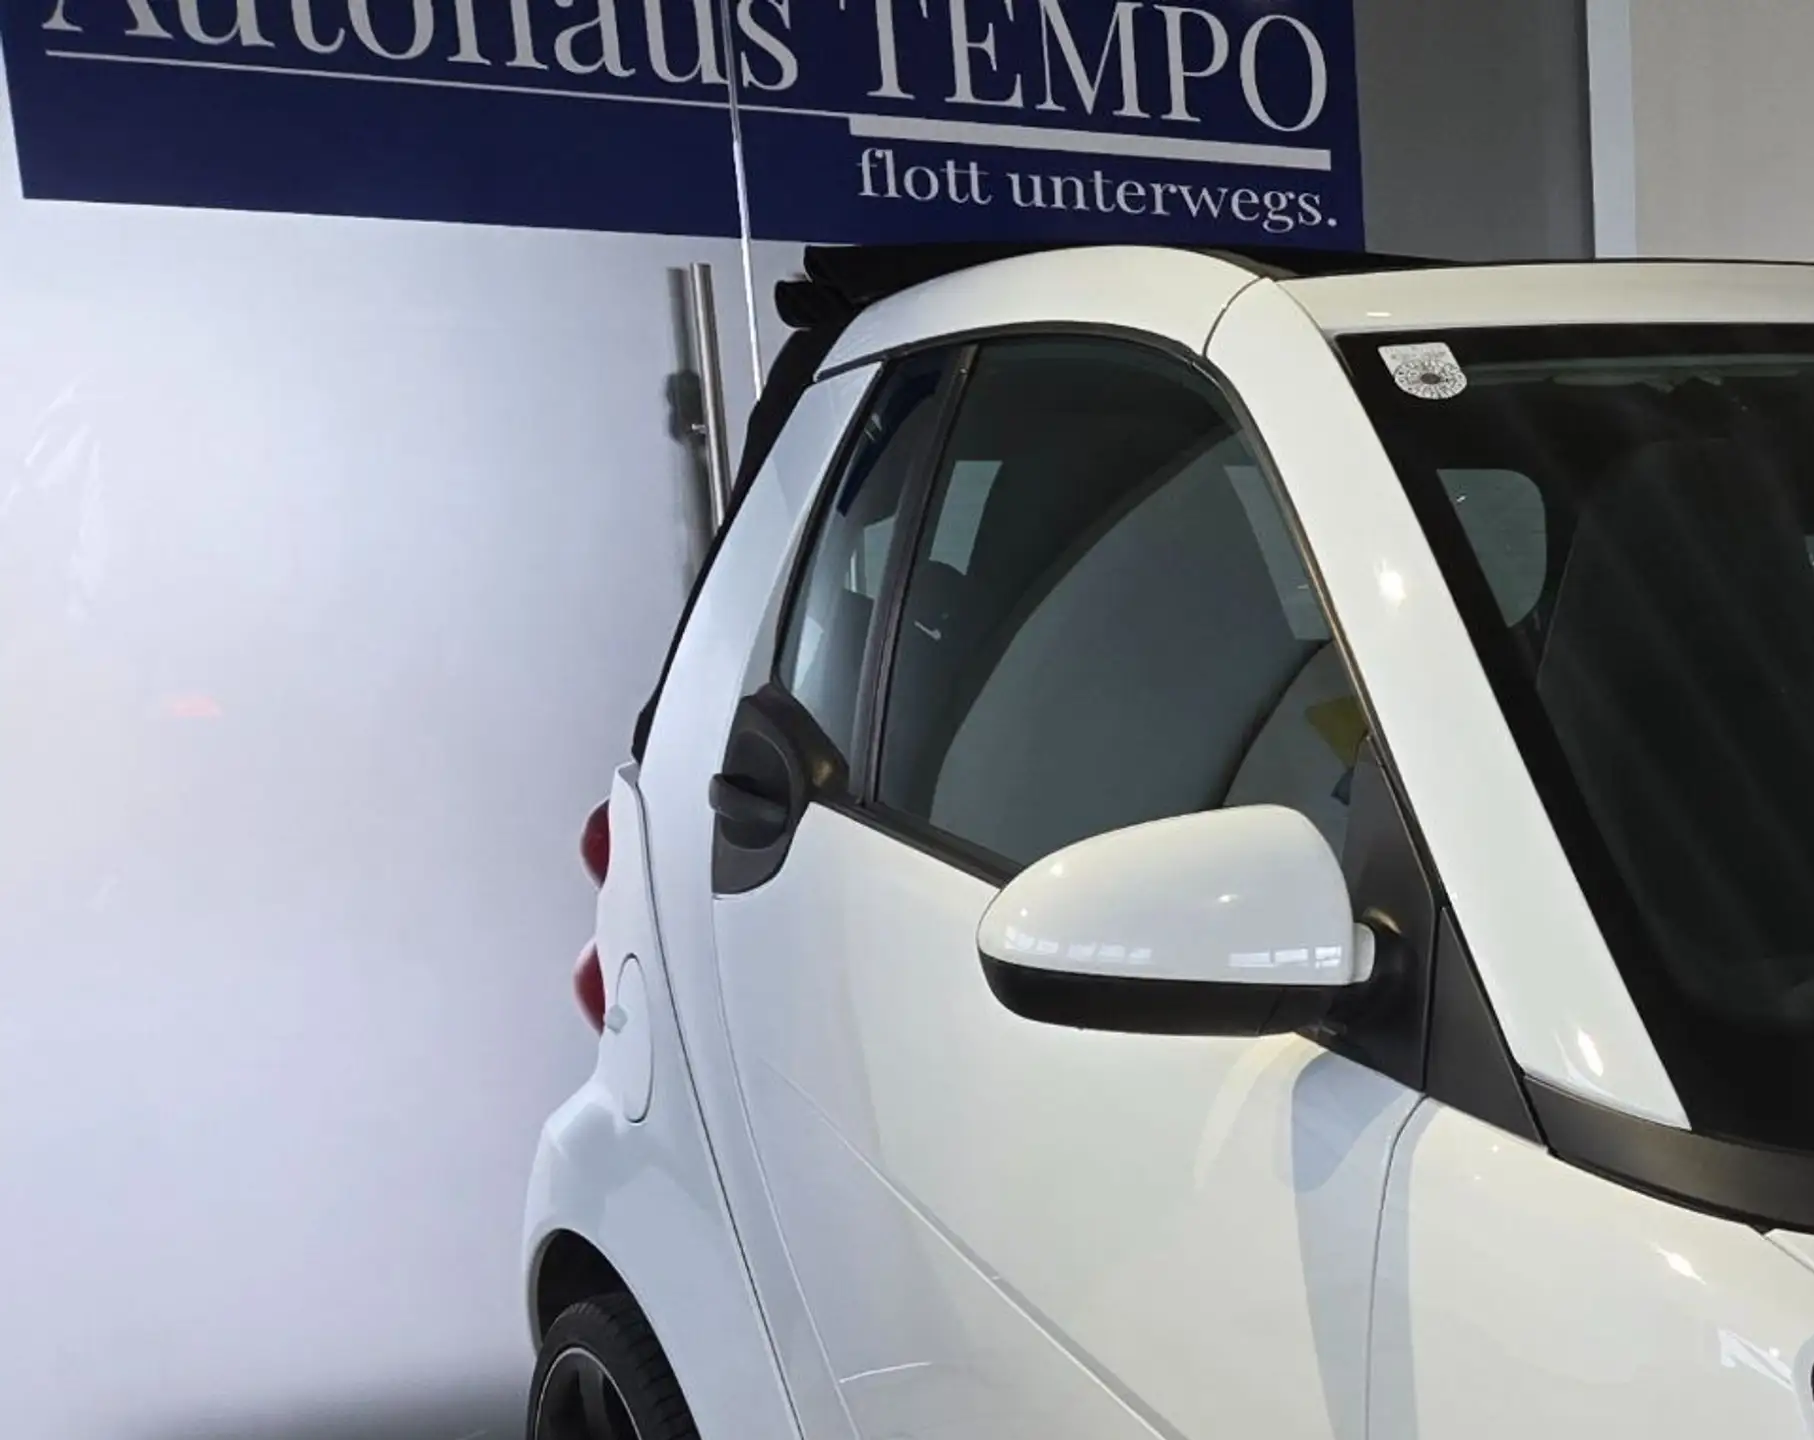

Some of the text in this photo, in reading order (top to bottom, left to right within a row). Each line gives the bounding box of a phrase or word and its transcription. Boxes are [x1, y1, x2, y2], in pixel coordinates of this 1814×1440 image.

[838, 0, 1327, 132] TEMPO
[857, 147, 1338, 233] flott unterwegs.
